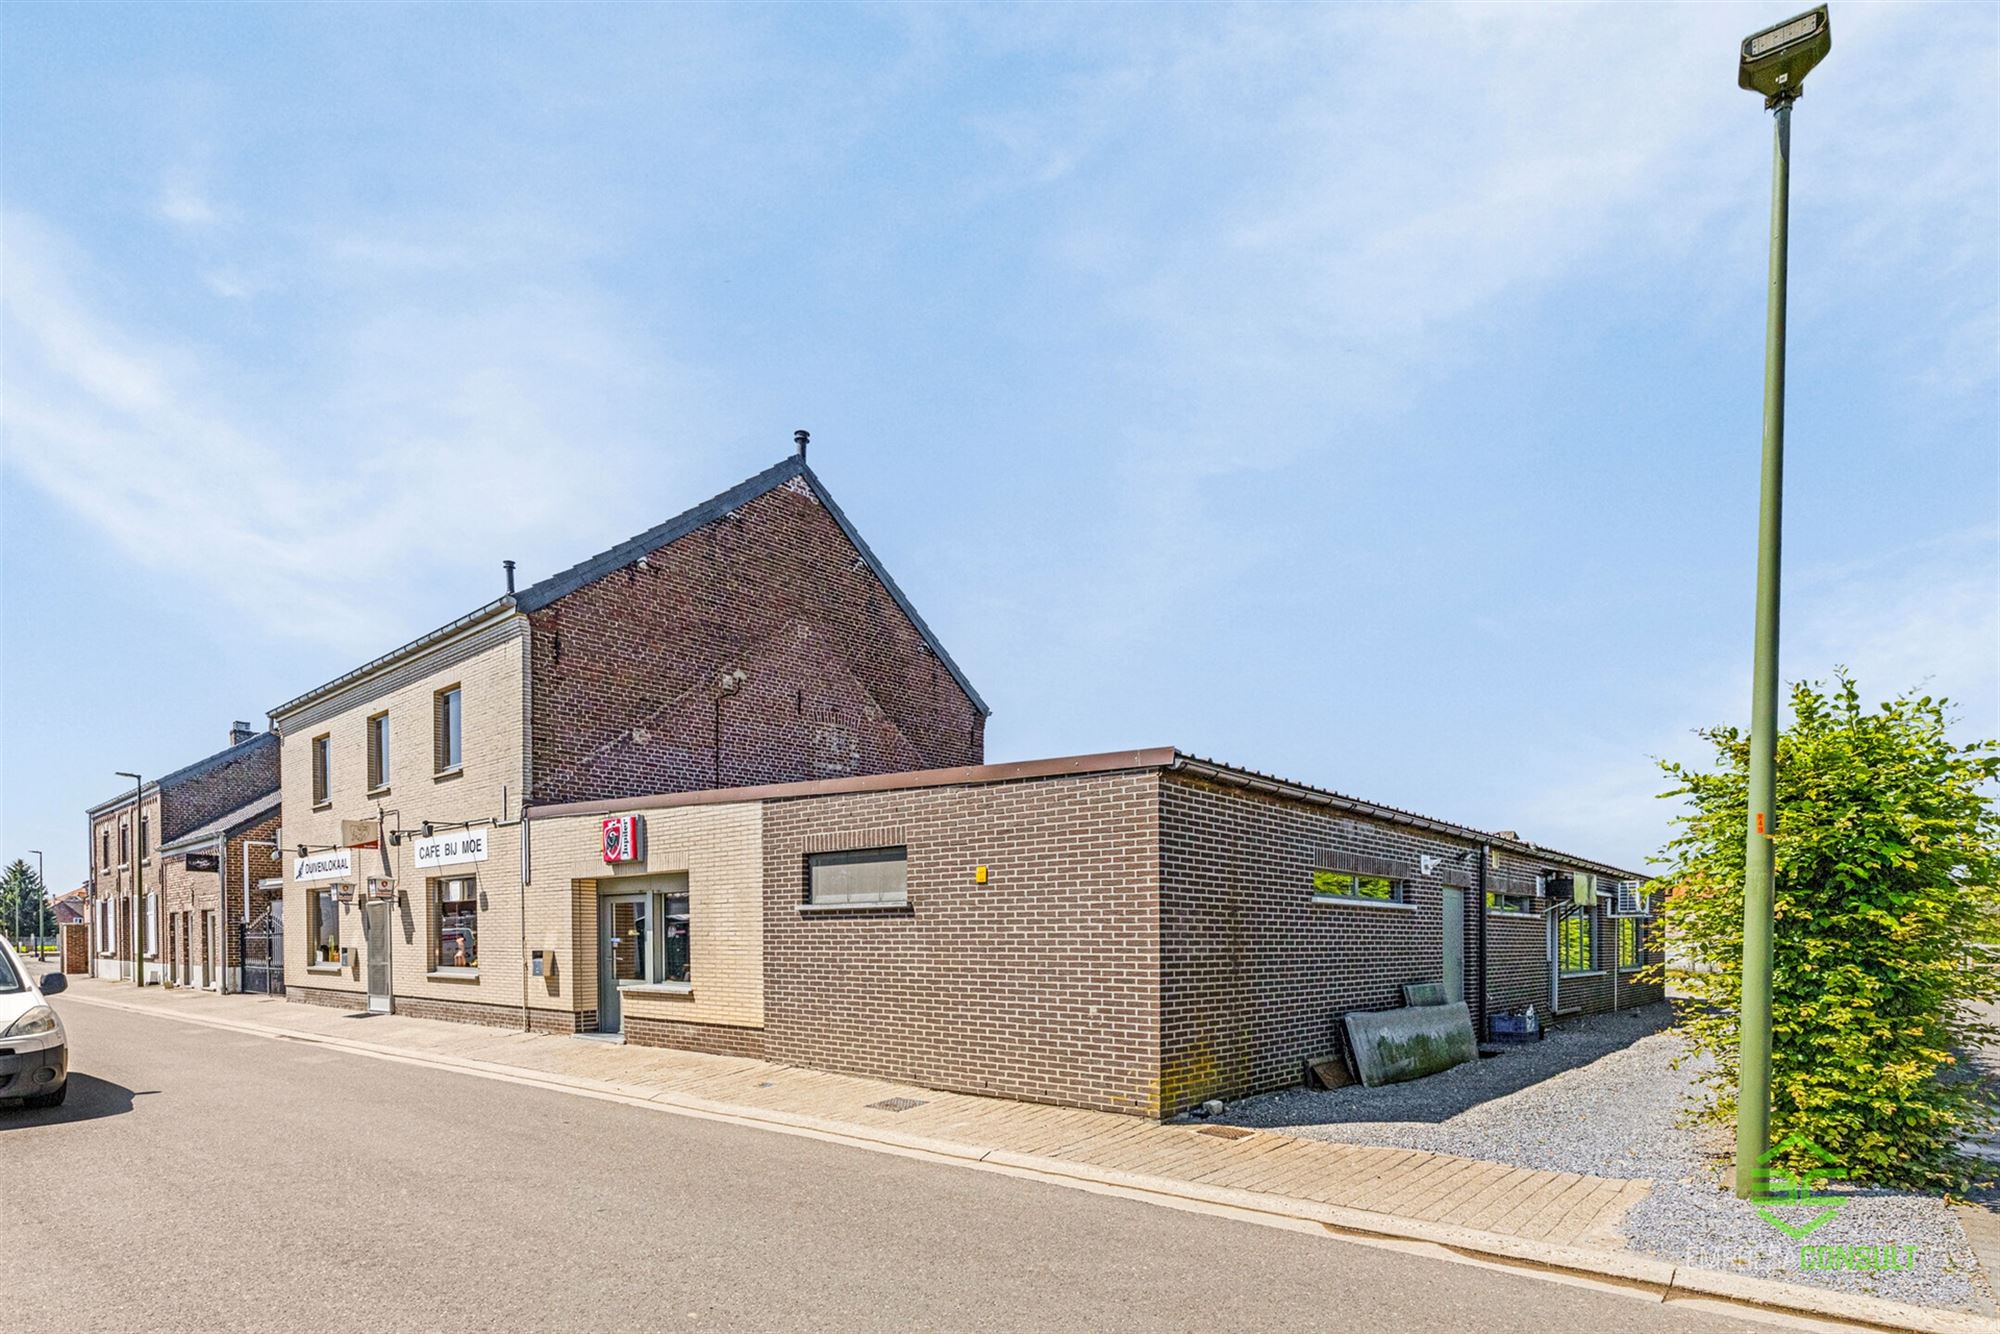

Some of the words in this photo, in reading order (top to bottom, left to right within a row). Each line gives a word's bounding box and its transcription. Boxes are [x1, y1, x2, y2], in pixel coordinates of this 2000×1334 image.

[622, 818, 630, 856] Jupiler
[419, 845, 440, 860] CAFE
[444, 842, 458, 856] BIJ
[462, 838, 482, 854] MOE
[305, 858, 349, 874] DUIVENLOKAAL
